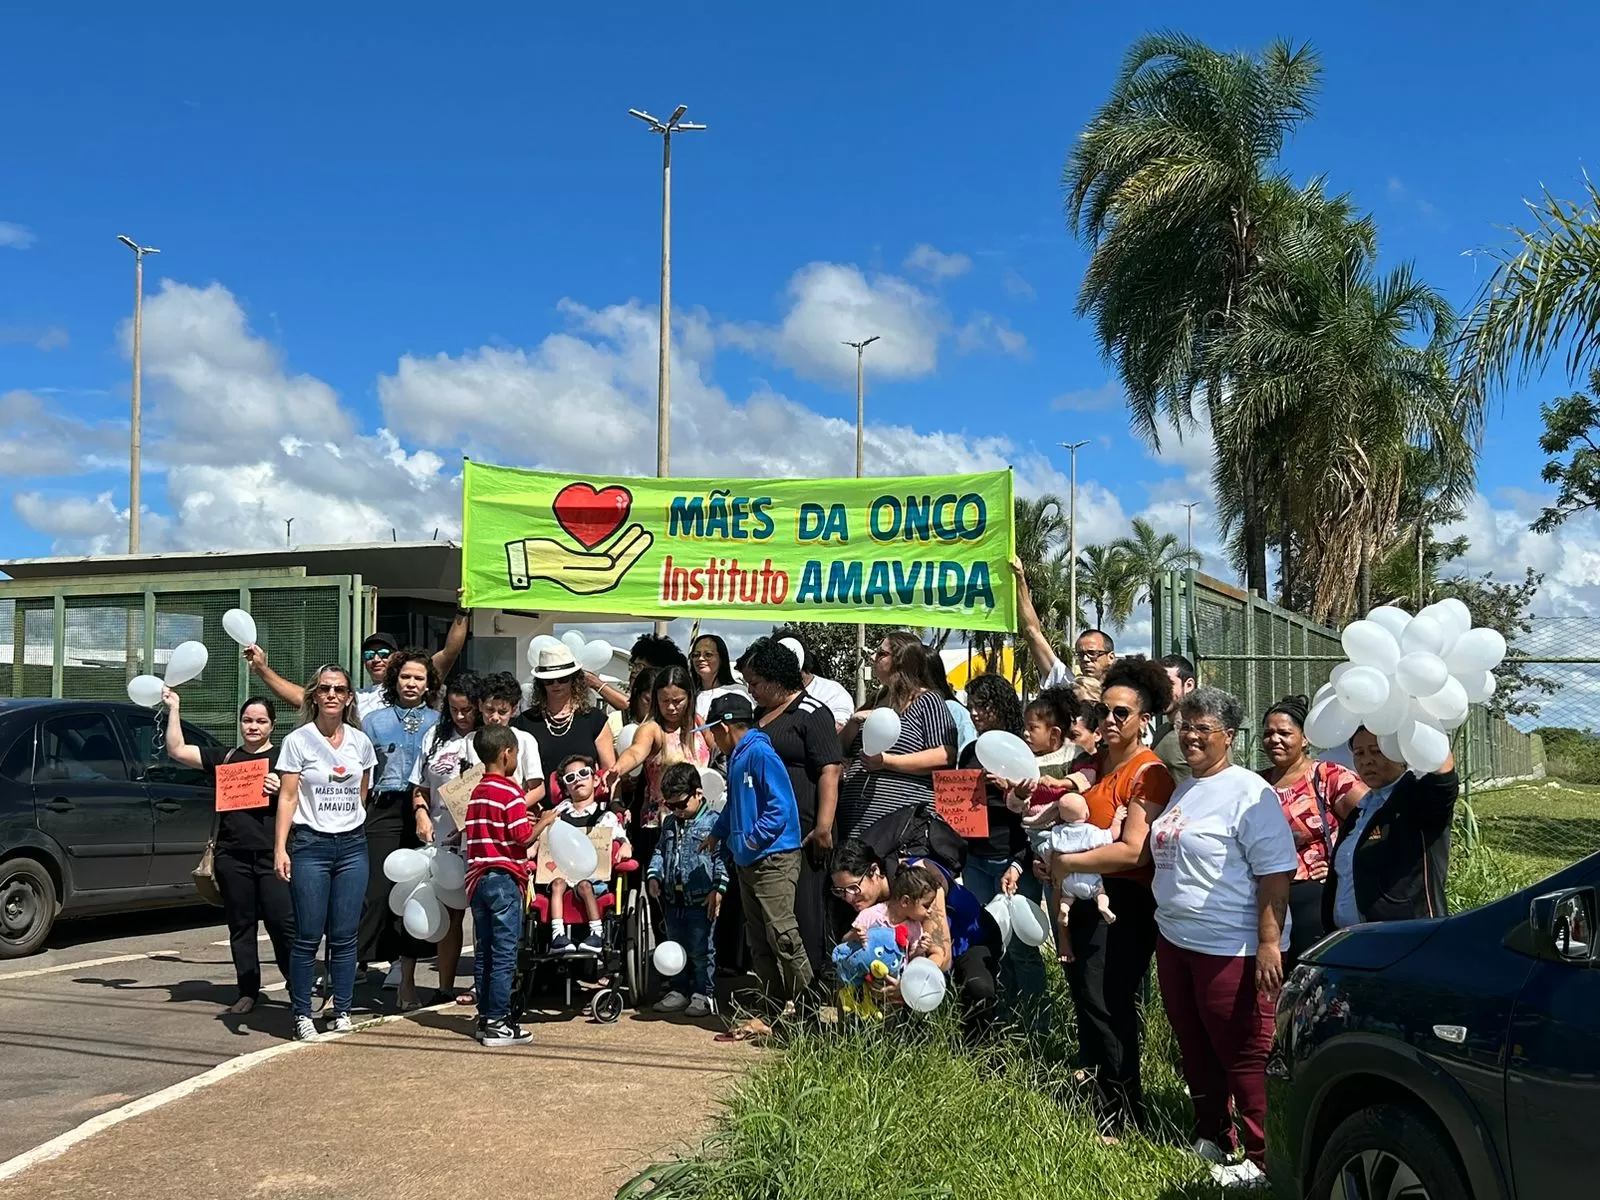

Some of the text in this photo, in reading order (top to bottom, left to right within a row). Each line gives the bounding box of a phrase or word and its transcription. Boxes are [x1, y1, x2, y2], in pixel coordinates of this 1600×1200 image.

[668, 488, 987, 542] MÃES DA ONCO
[662, 555, 995, 609] Instituto AMAVIDA
[318, 802, 356, 812] AMAVIDA
